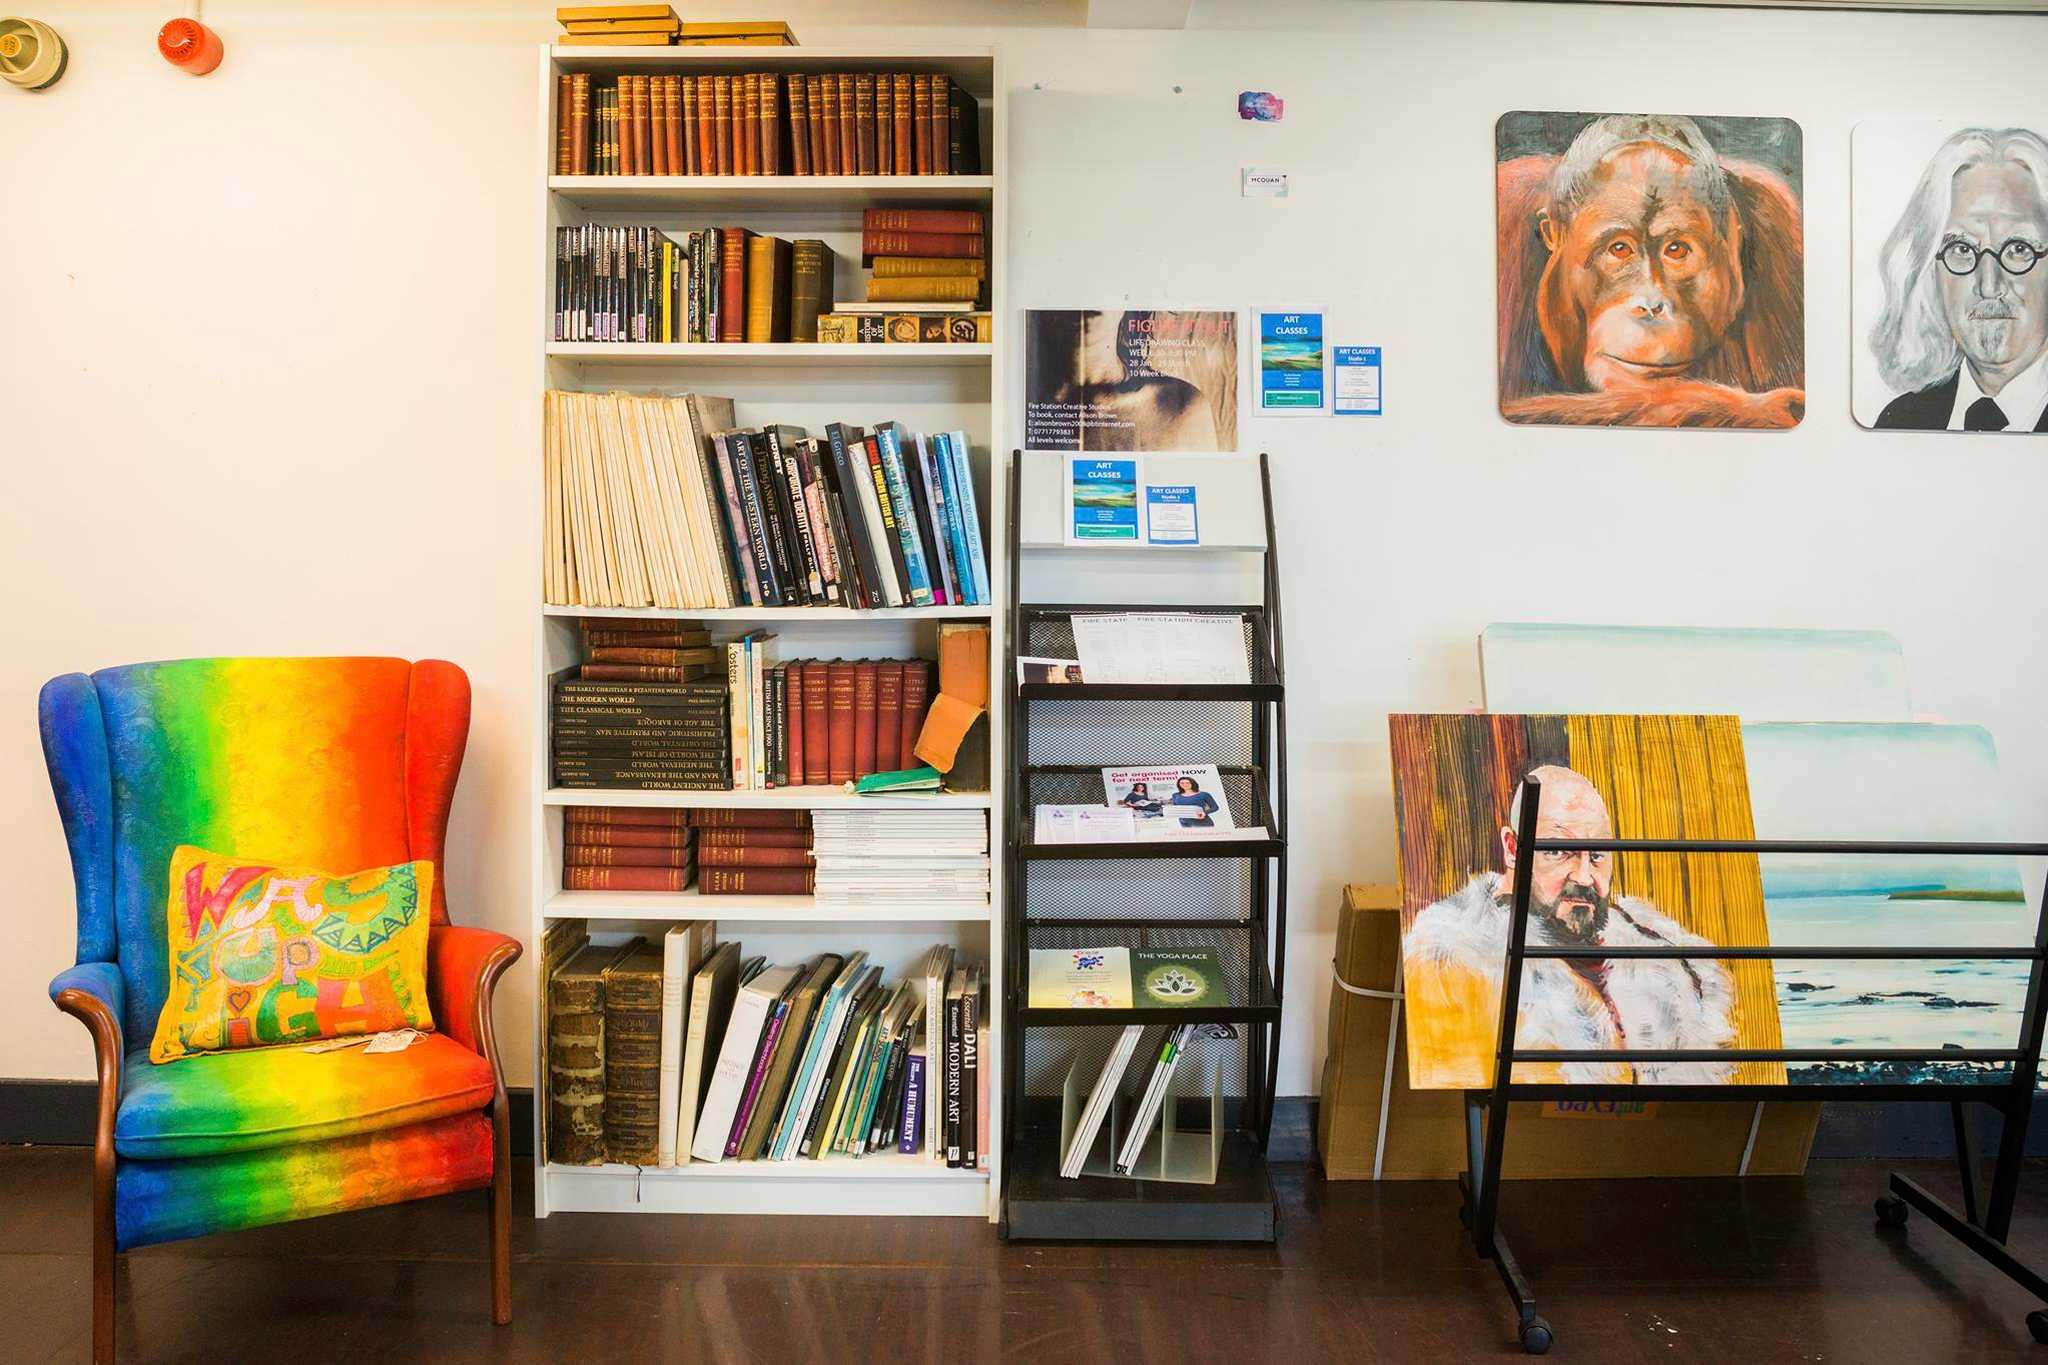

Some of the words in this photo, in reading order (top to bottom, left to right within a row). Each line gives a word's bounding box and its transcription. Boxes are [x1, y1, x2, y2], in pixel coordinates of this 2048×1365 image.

[830, 430, 839, 440] El
[735, 438, 745, 457] ART
[769, 433, 784, 475] MONET
[832, 440, 846, 466] Greco
[739, 458, 748, 471] OF
[741, 473, 752, 492] THE
[746, 492, 761, 535] WESTERN
[883, 516, 895, 528] ART
[753, 537, 768, 571] WORLD
[636, 718, 671, 726] BAROQUE
[1132, 769, 1179, 778] organised
[963, 995, 972, 1031] Essential
[963, 1033, 975, 1068] DALI
[948, 1041, 959, 1095] MODERN
[908, 1081, 918, 1089] A
[948, 1099, 959, 1124] ART
